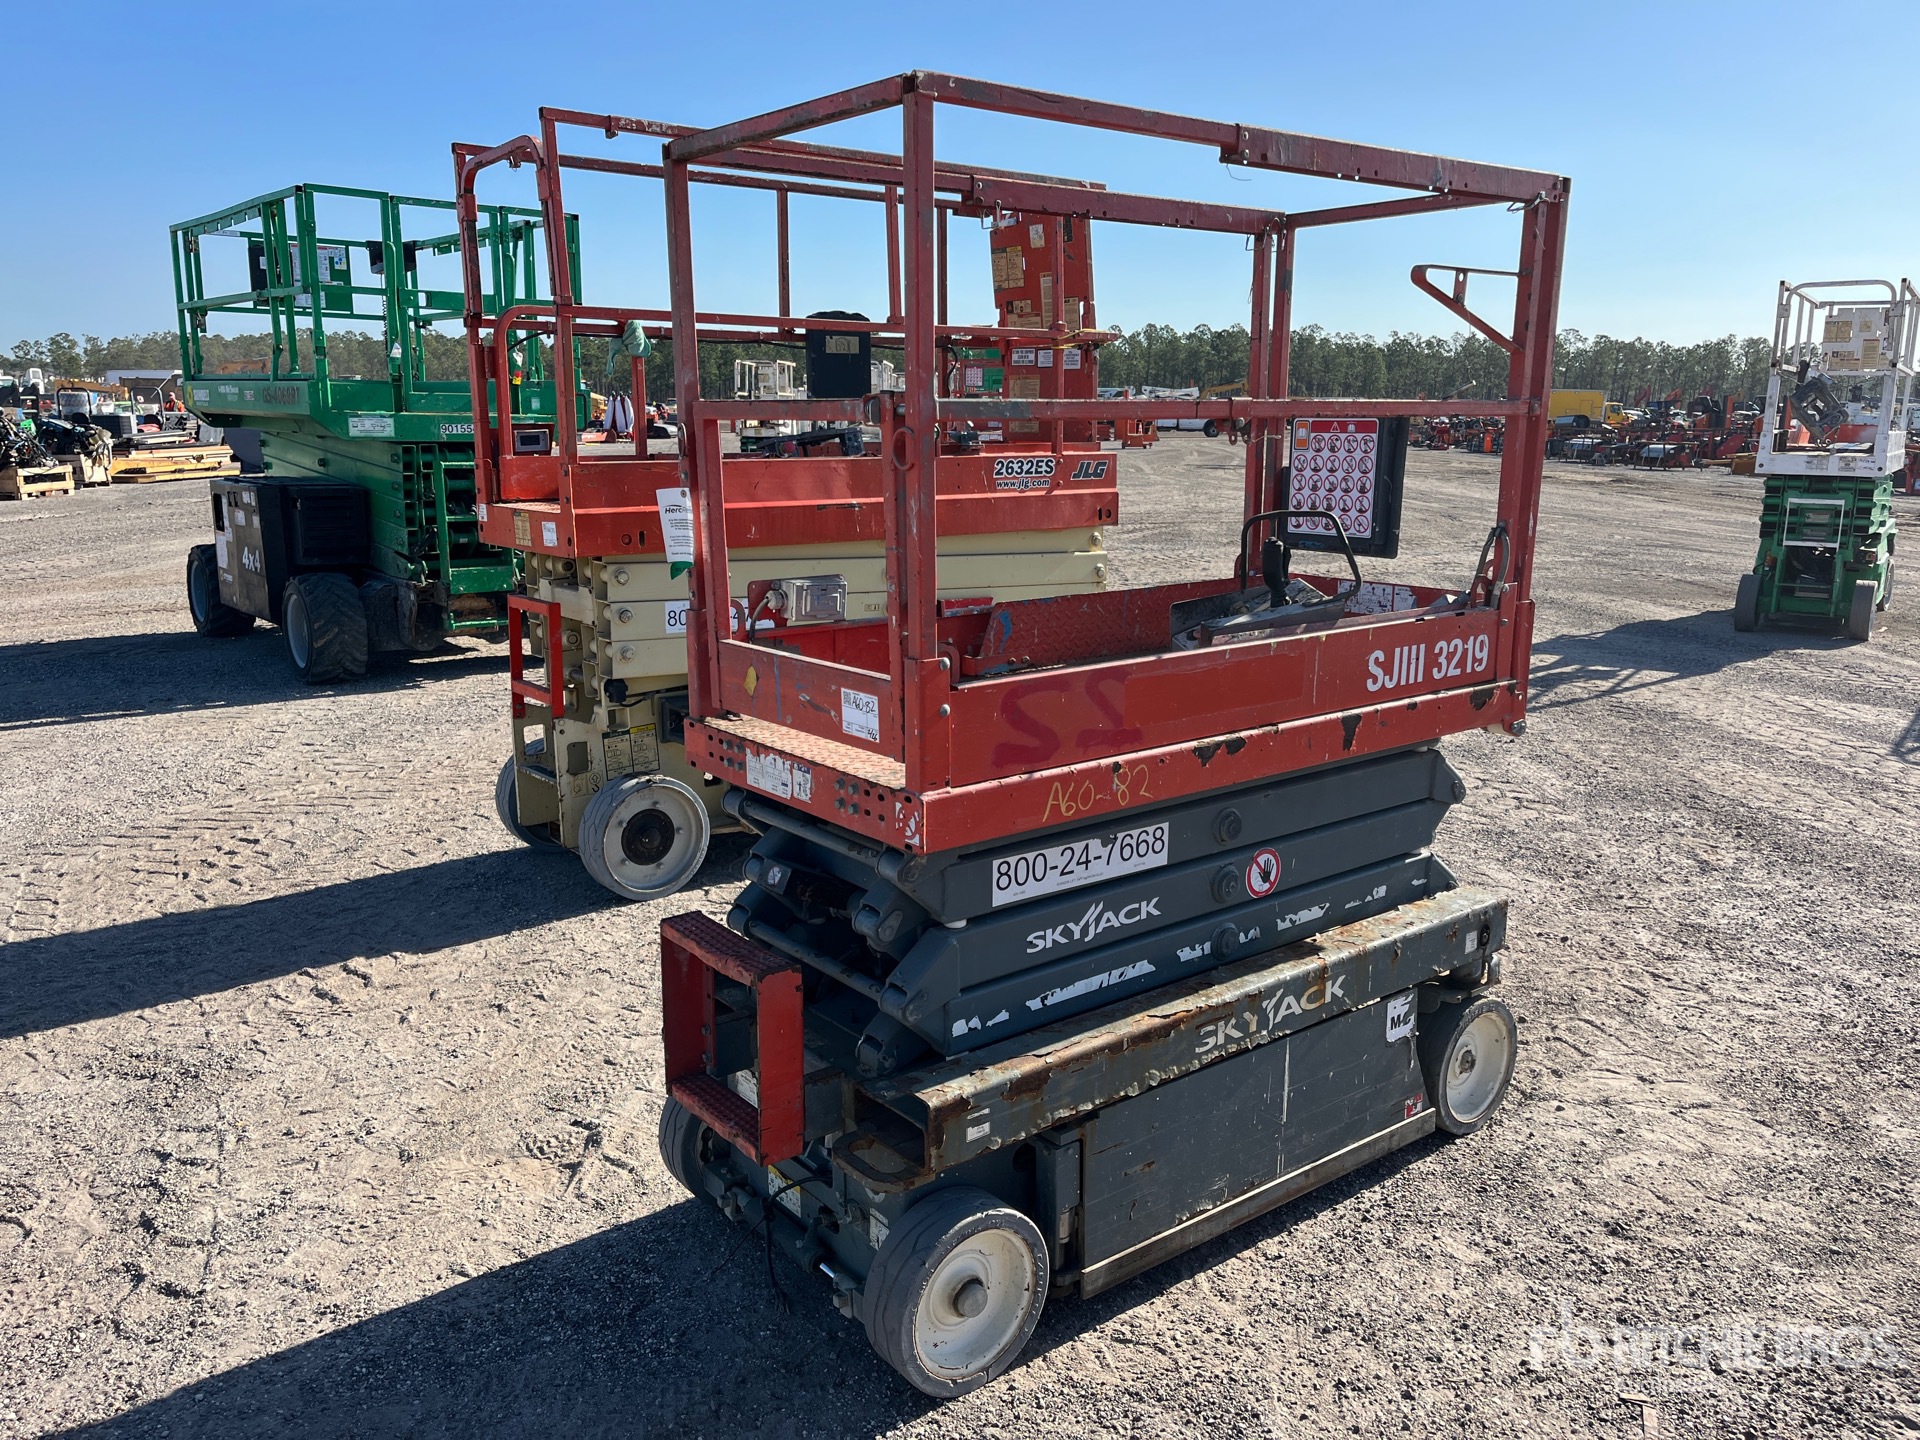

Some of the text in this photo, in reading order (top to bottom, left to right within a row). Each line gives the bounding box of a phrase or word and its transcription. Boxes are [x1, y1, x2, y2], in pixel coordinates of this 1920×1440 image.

[441, 424, 474, 433] 90155
[994, 459, 1108, 479] 2632ES JLG
[996, 479, 1050, 489] www.jlg.com
[242, 546, 260, 572] 4x4
[1366, 634, 1489, 692] SJIII 3219
[852, 695, 876, 714] A60-82
[1042, 764, 1153, 822] A60-82
[996, 826, 1165, 891] 800-24-7668
[1026, 897, 1162, 954] SKYJACK
[1195, 975, 1346, 1054] SKYJACK
